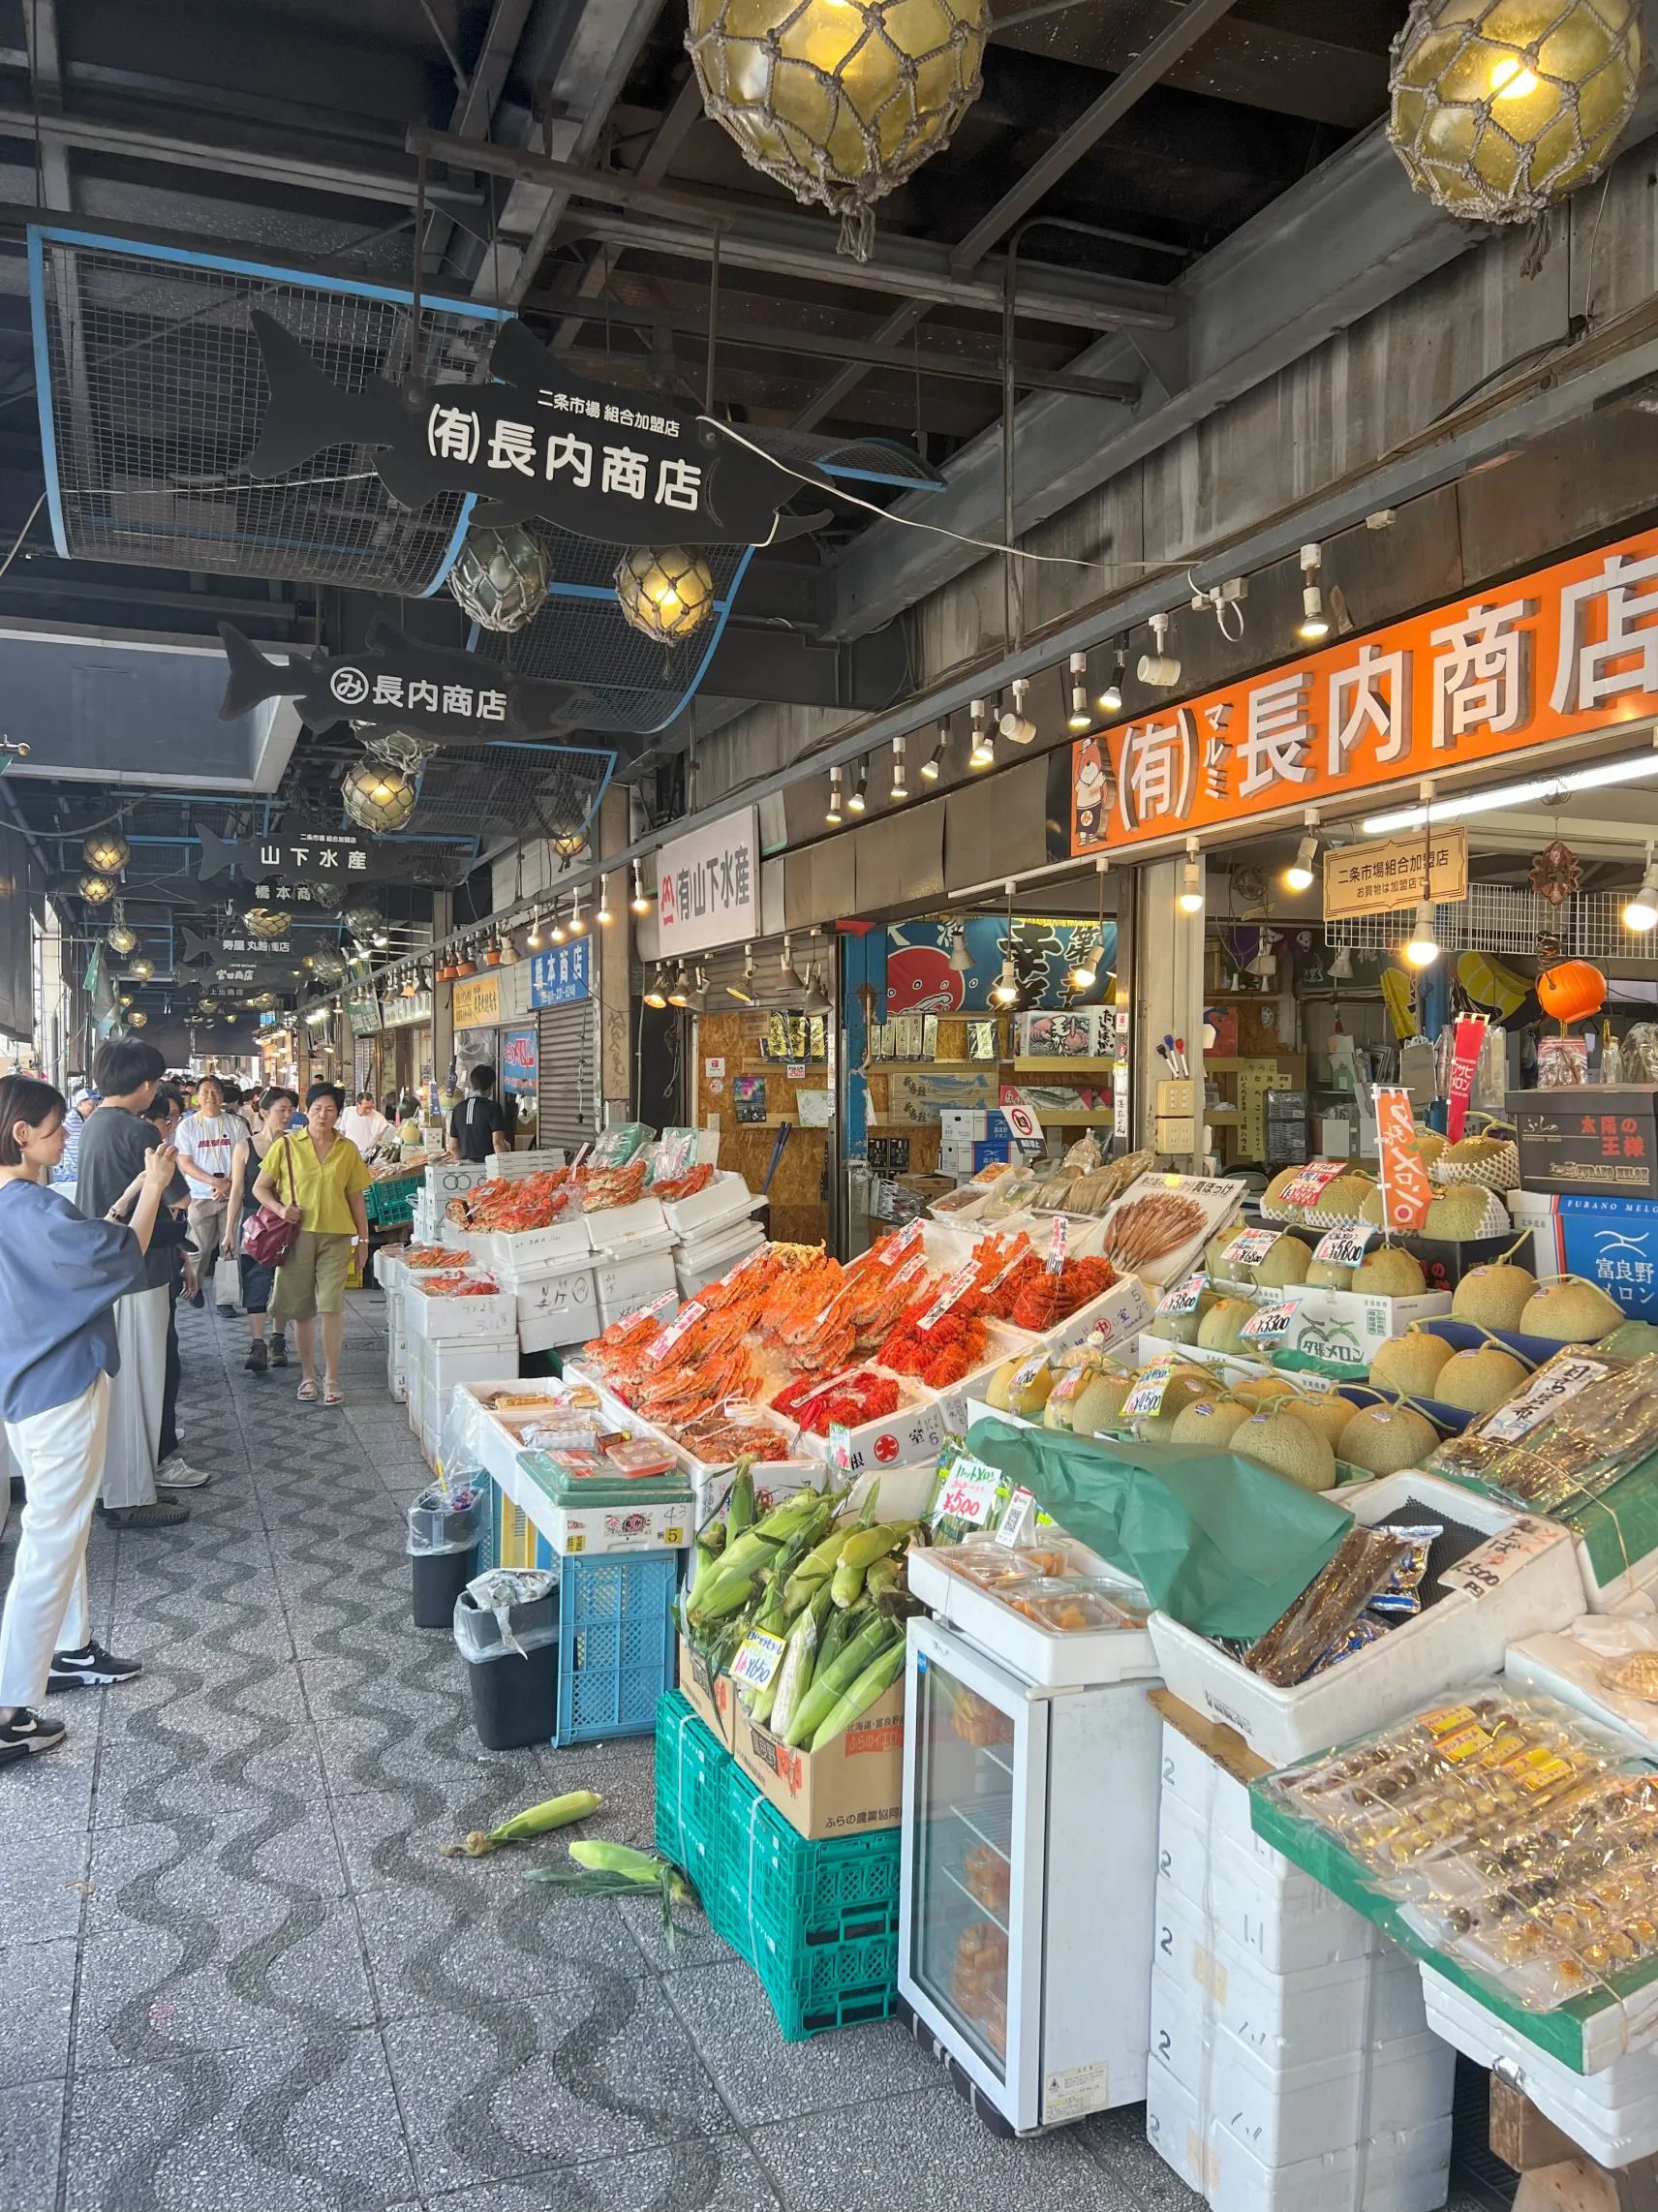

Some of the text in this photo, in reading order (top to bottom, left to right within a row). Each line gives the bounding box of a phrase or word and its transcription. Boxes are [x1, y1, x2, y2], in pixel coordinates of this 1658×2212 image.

[537, 390, 680, 438] 二条市場 組合加盟店
[1204, 702, 1233, 801] マルミ
[1237, 554, 1658, 799] 長内商店
[373, 675, 507, 721] 長内商店
[261, 845, 367, 870] 山下水産
[1338, 849, 1449, 884] 二条市場組合加盟店
[1581, 1116, 1637, 1134] 太陽の
[1602, 1136, 1644, 1156] 王様
[1567, 1200, 1617, 1210] FURANO
[1595, 1258, 1654, 1283] 富良野
[1603, 1283, 1655, 1305] メロン
[942, 1489, 980, 1517] ¥500
[668, 1529, 677, 1543] 5
[1163, 1757, 1175, 1785] 2
[825, 1806, 903, 1828] ふらの農業協同
[1160, 1850, 1172, 1878] 2
[1160, 1927, 1173, 1956] 2
[1158, 2030, 1172, 2061] 2
